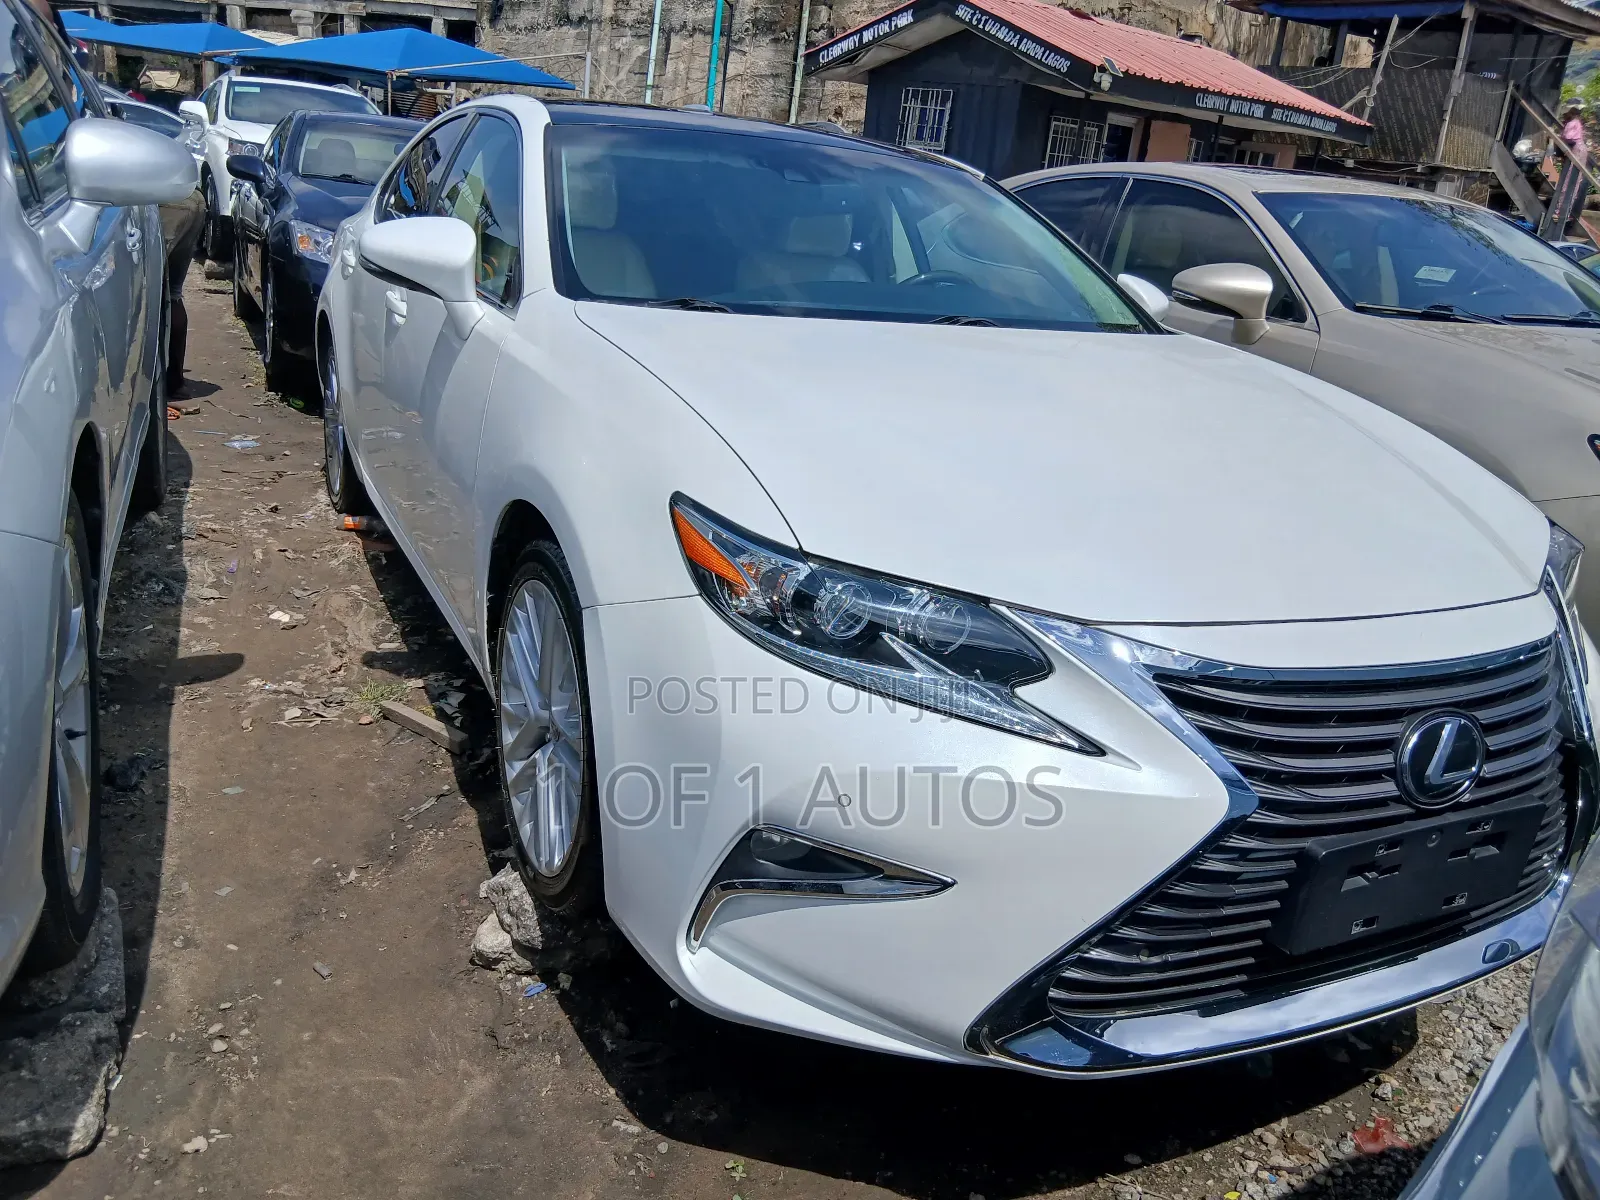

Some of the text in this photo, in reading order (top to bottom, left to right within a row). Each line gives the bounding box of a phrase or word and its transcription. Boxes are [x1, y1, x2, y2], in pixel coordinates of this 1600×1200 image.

[819, 8, 914, 64] CLEARWAY MOTOR PARK
[955, 4, 974, 22] SITE
[1018, 38, 1045, 60] APAPA
[1041, 50, 1071, 73] LAGOS
[1195, 92, 1266, 119] CLEARWAY MOTOR PARK
